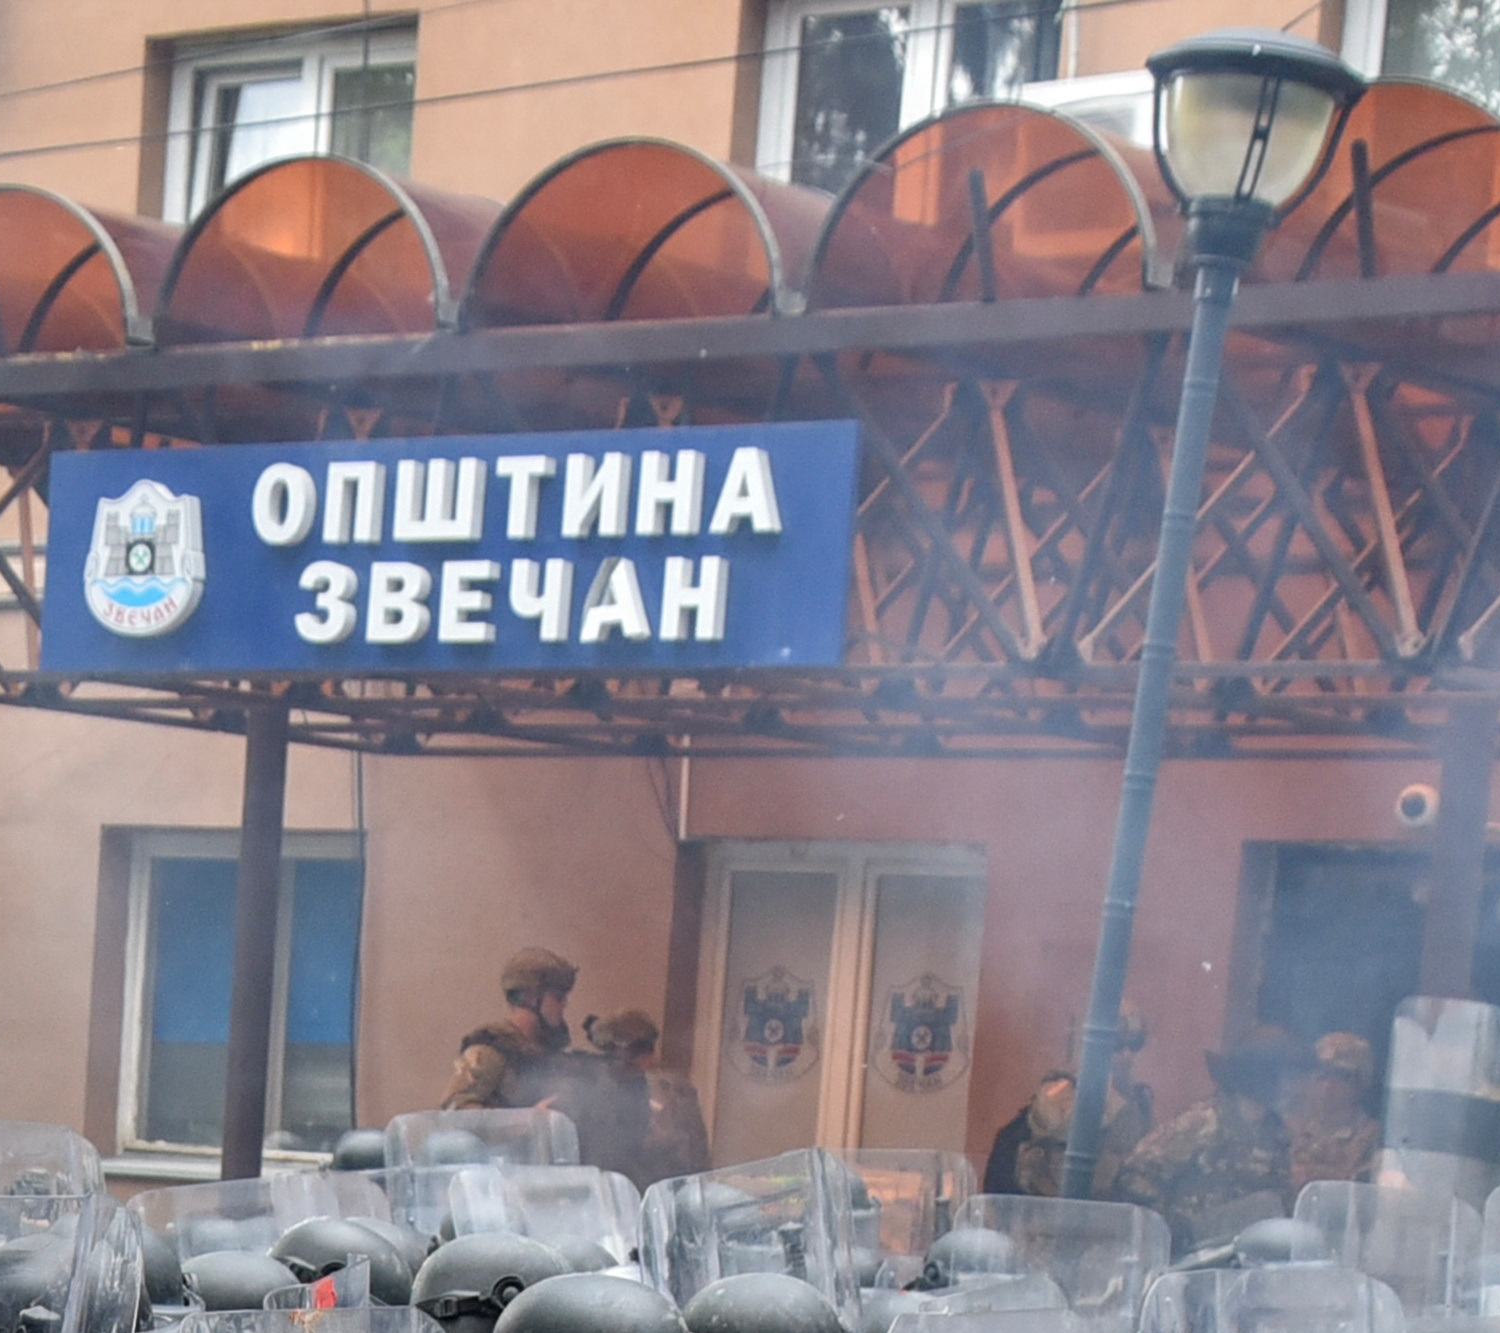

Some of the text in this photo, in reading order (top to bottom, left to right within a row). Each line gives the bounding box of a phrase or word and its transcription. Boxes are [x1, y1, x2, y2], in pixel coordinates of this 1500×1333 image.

[252, 446, 783, 546] ОПШТИНА
[104, 596, 177, 625] ЗВЕЧАН
[294, 554, 730, 645] ЗВЕЧАН
